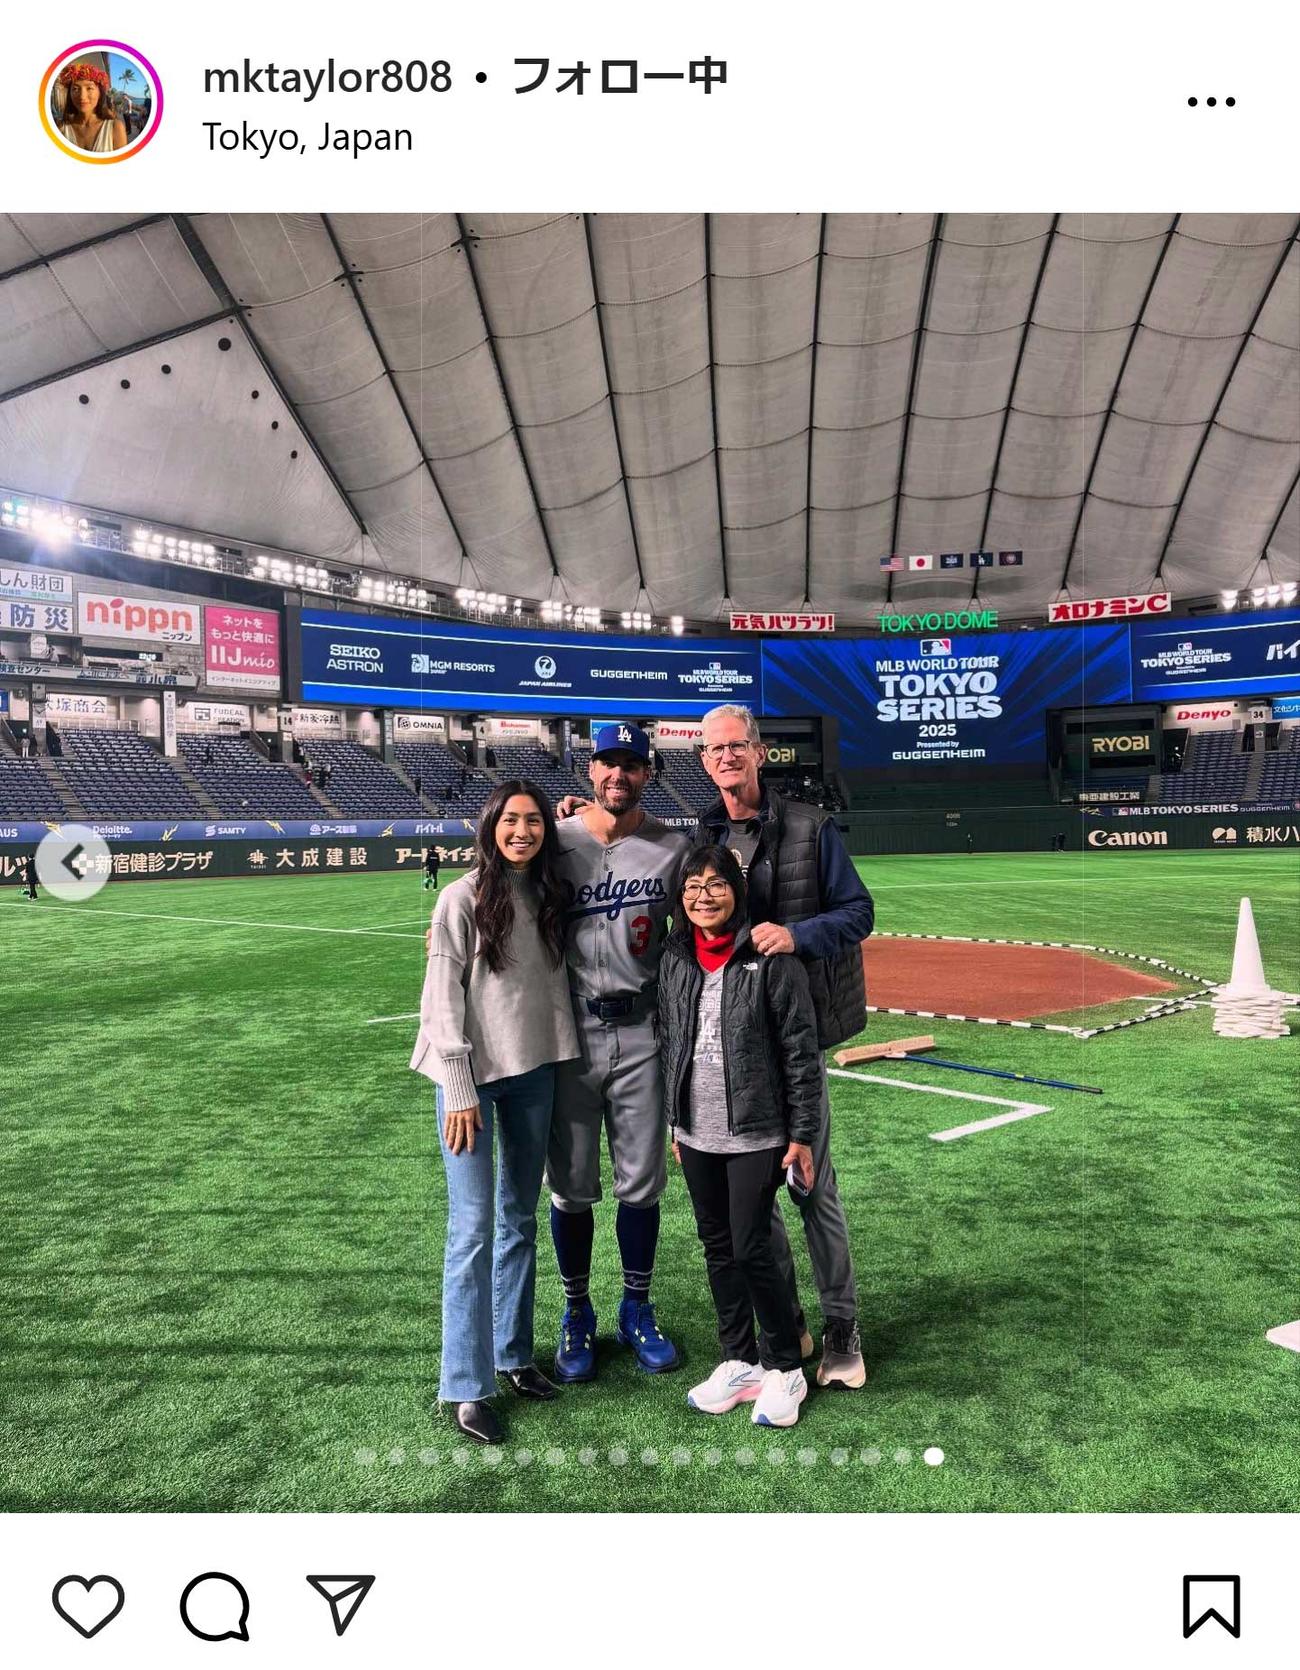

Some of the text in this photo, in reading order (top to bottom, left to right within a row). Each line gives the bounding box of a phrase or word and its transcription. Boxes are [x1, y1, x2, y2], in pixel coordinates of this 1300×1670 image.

[1052, 594, 1168, 621] オロナミンC
[0, 603, 69, 631] 防災
[87, 598, 193, 633] nippn
[222, 614, 263, 629] ネットを
[877, 610, 999, 633] TOKYO DOME
[162, 632, 193, 642] ニップン
[210, 627, 275, 644] もっと快適に
[329, 644, 381, 659] SEIKO
[327, 659, 384, 673] ASTRON
[430, 660, 452, 670] MGM
[453, 662, 496, 673] RESORTS
[876, 655, 1000, 673] MLB WORLD TOUR
[1141, 652, 1232, 668] TOKYO SERIES
[590, 669, 668, 681] GUGGENHEIM
[678, 674, 753, 685] TOKYO SERIES
[878, 671, 998, 698] TOKYO
[876, 695, 1003, 722] SERIES
[1177, 709, 1232, 720] Denyo
[1253, 711, 1263, 719] 34
[284, 716, 293, 726] 14
[413, 721, 443, 730] OMNIA
[480, 726, 485, 734] 4
[618, 725, 632, 743] LA
[660, 728, 703, 739] Denyo
[918, 724, 957, 737] 2025
[1092, 735, 1150, 753] RYOBI
[764, 748, 796, 763] OBI
[892, 749, 986, 760] GUGGENHEIM
[1129, 803, 1239, 815] MLB TOKYO SERIES
[664, 818, 681, 827] MLB
[217, 827, 247, 835] SAMTY
[1088, 830, 1168, 847] Canon
[1246, 826, 1300, 843] 積水ハ
[95, 850, 214, 874] 新宿健診プラザ
[276, 847, 368, 868] 大成建設
[629, 915, 653, 957] 3
